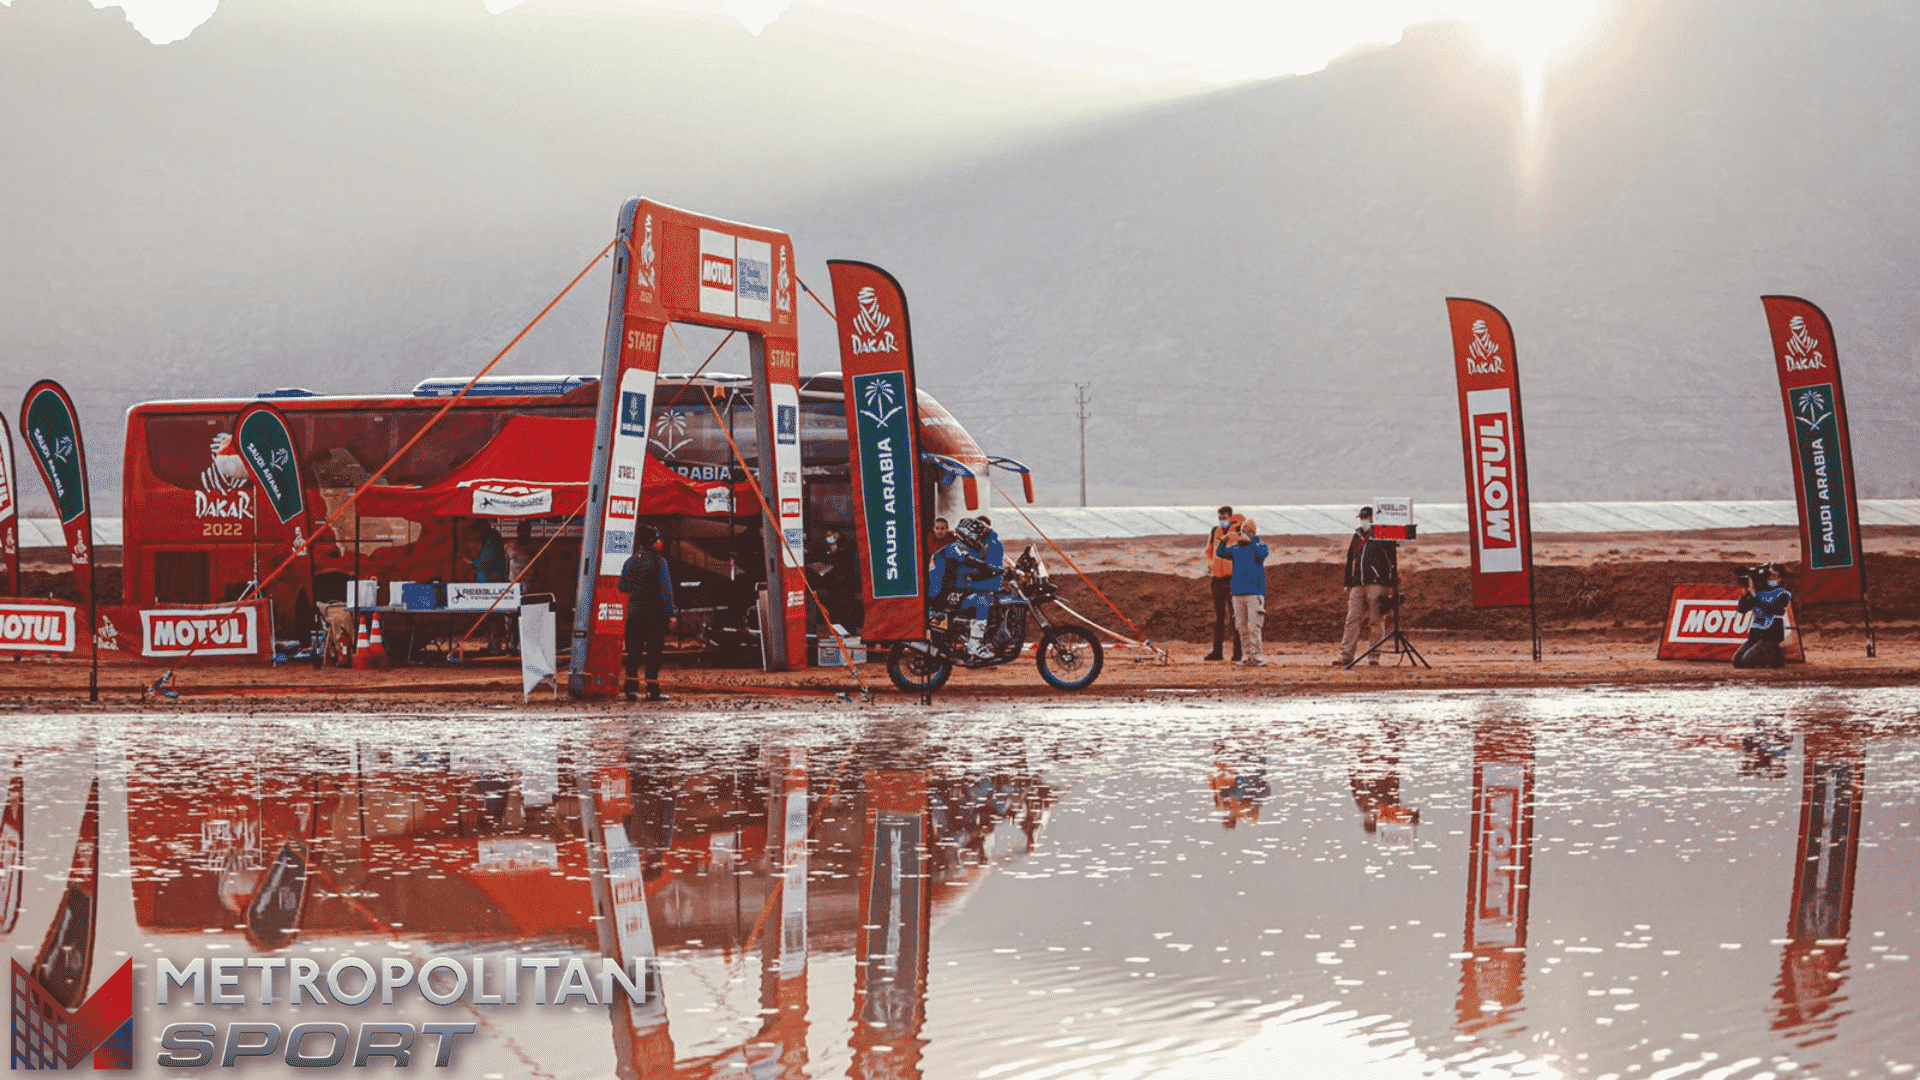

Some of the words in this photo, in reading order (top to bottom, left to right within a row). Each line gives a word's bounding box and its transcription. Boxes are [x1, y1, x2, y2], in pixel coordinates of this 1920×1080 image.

[702, 259, 733, 286] MOTUL
[627, 329, 658, 353] START
[851, 330, 900, 357] DAKAR
[770, 349, 796, 369] START
[1466, 355, 1506, 375] DAKAR
[1785, 351, 1827, 372] DAKAR
[246, 442, 267, 469] SAUDI
[1811, 437, 1830, 501] ARABIA
[877, 436, 896, 515] ARABIA
[1479, 418, 1512, 543] MOTUL
[195, 489, 254, 519] DAKAR
[202, 522, 243, 536] 2022
[1819, 504, 1836, 555] SAUDI
[884, 519, 899, 582] SAUDI
[154, 617, 243, 646] MOTUL
[1681, 609, 1754, 635] MOTU
